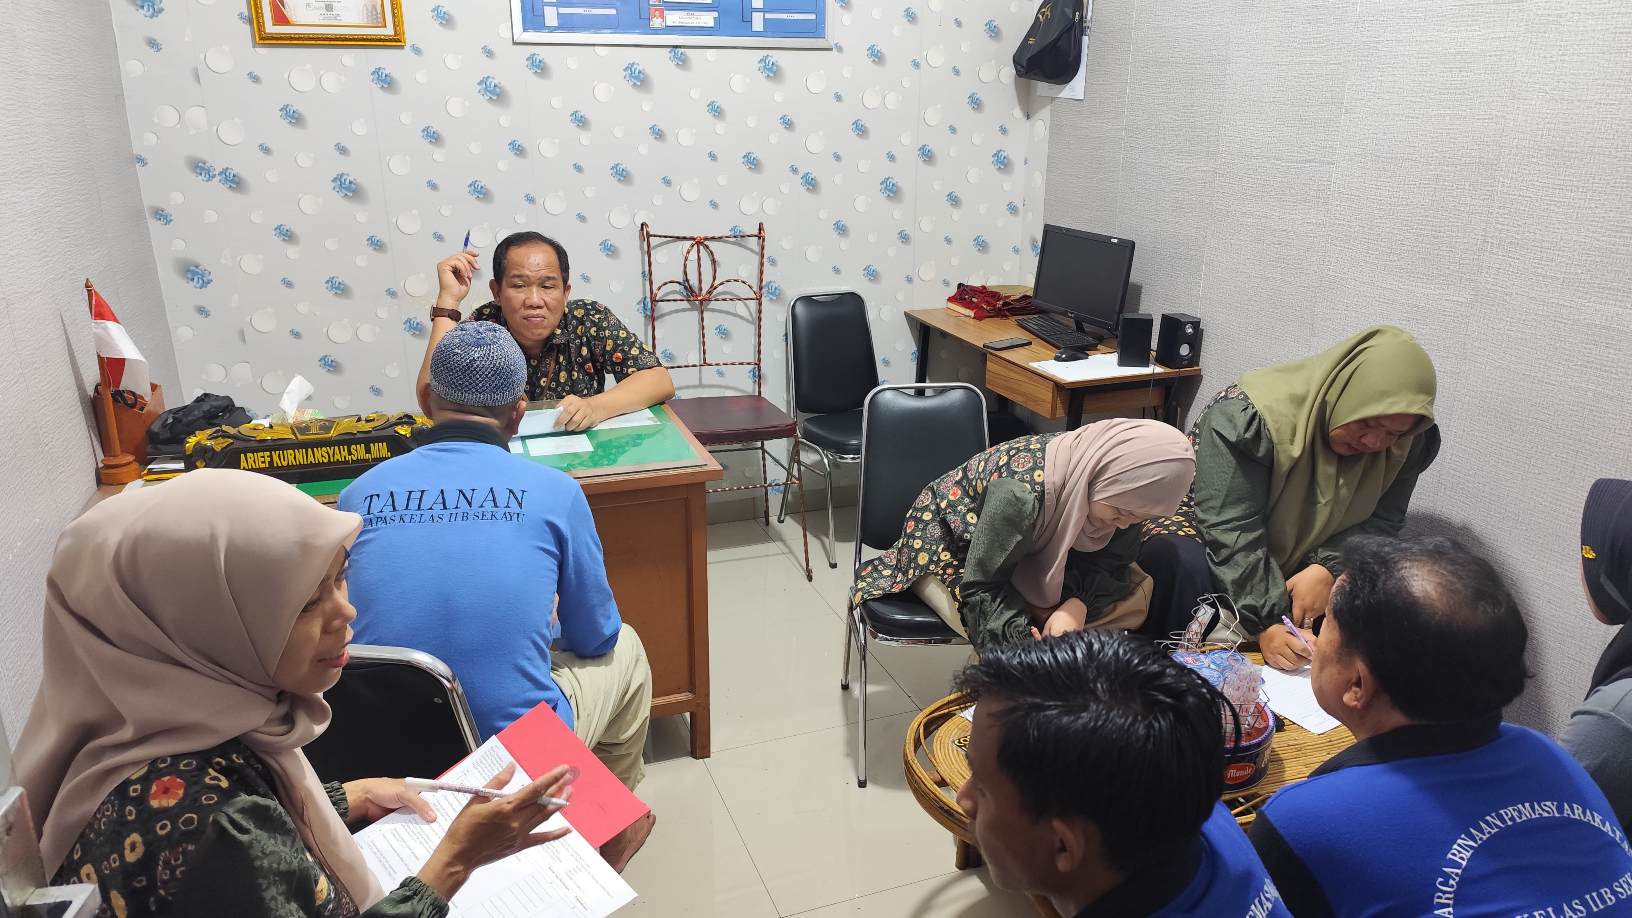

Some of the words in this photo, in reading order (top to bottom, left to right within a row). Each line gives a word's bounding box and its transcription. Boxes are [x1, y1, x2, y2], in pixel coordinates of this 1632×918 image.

[240, 451, 271, 470] ARIEF
[363, 487, 529, 516] TAHANAN
[363, 514, 396, 529] APAS
[398, 512, 445, 524] KELAS
